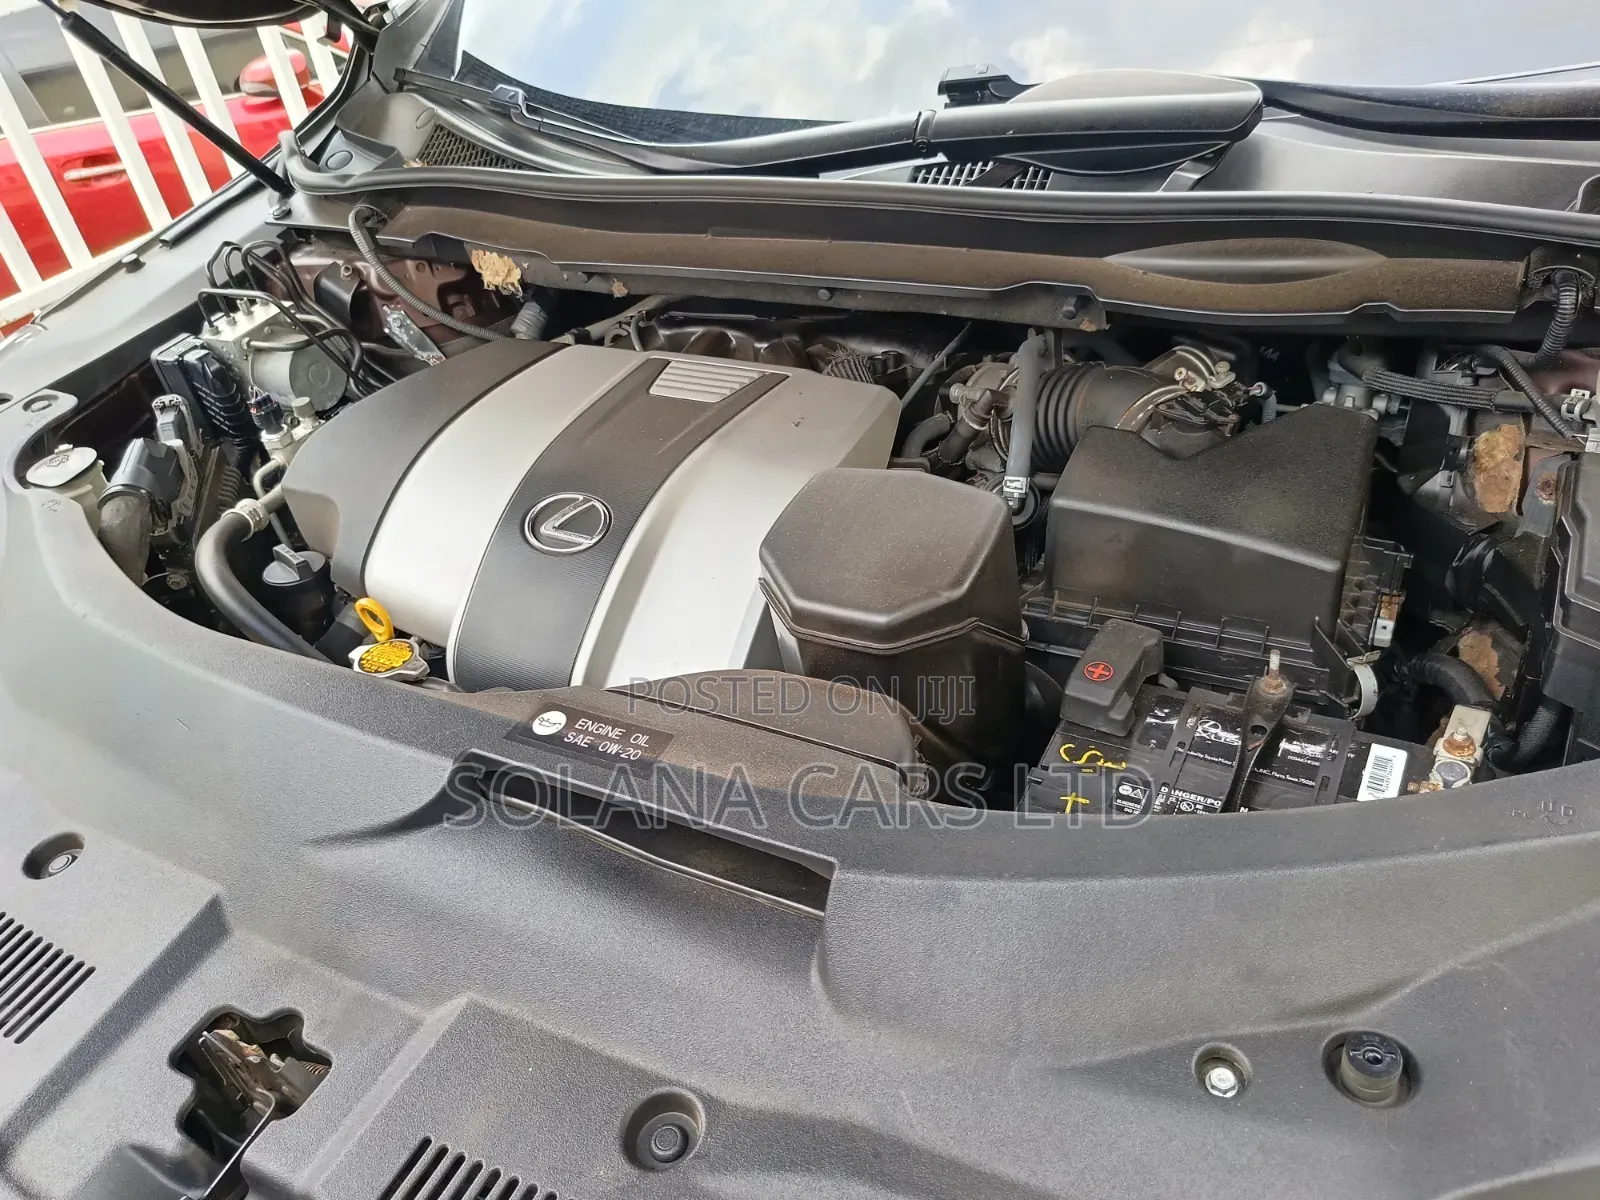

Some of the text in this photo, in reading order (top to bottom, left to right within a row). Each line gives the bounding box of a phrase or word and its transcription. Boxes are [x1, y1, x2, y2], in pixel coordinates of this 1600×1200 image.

[564, 731, 642, 761] SAE 0W-20
[575, 718, 650, 748] ENGINE OIL
